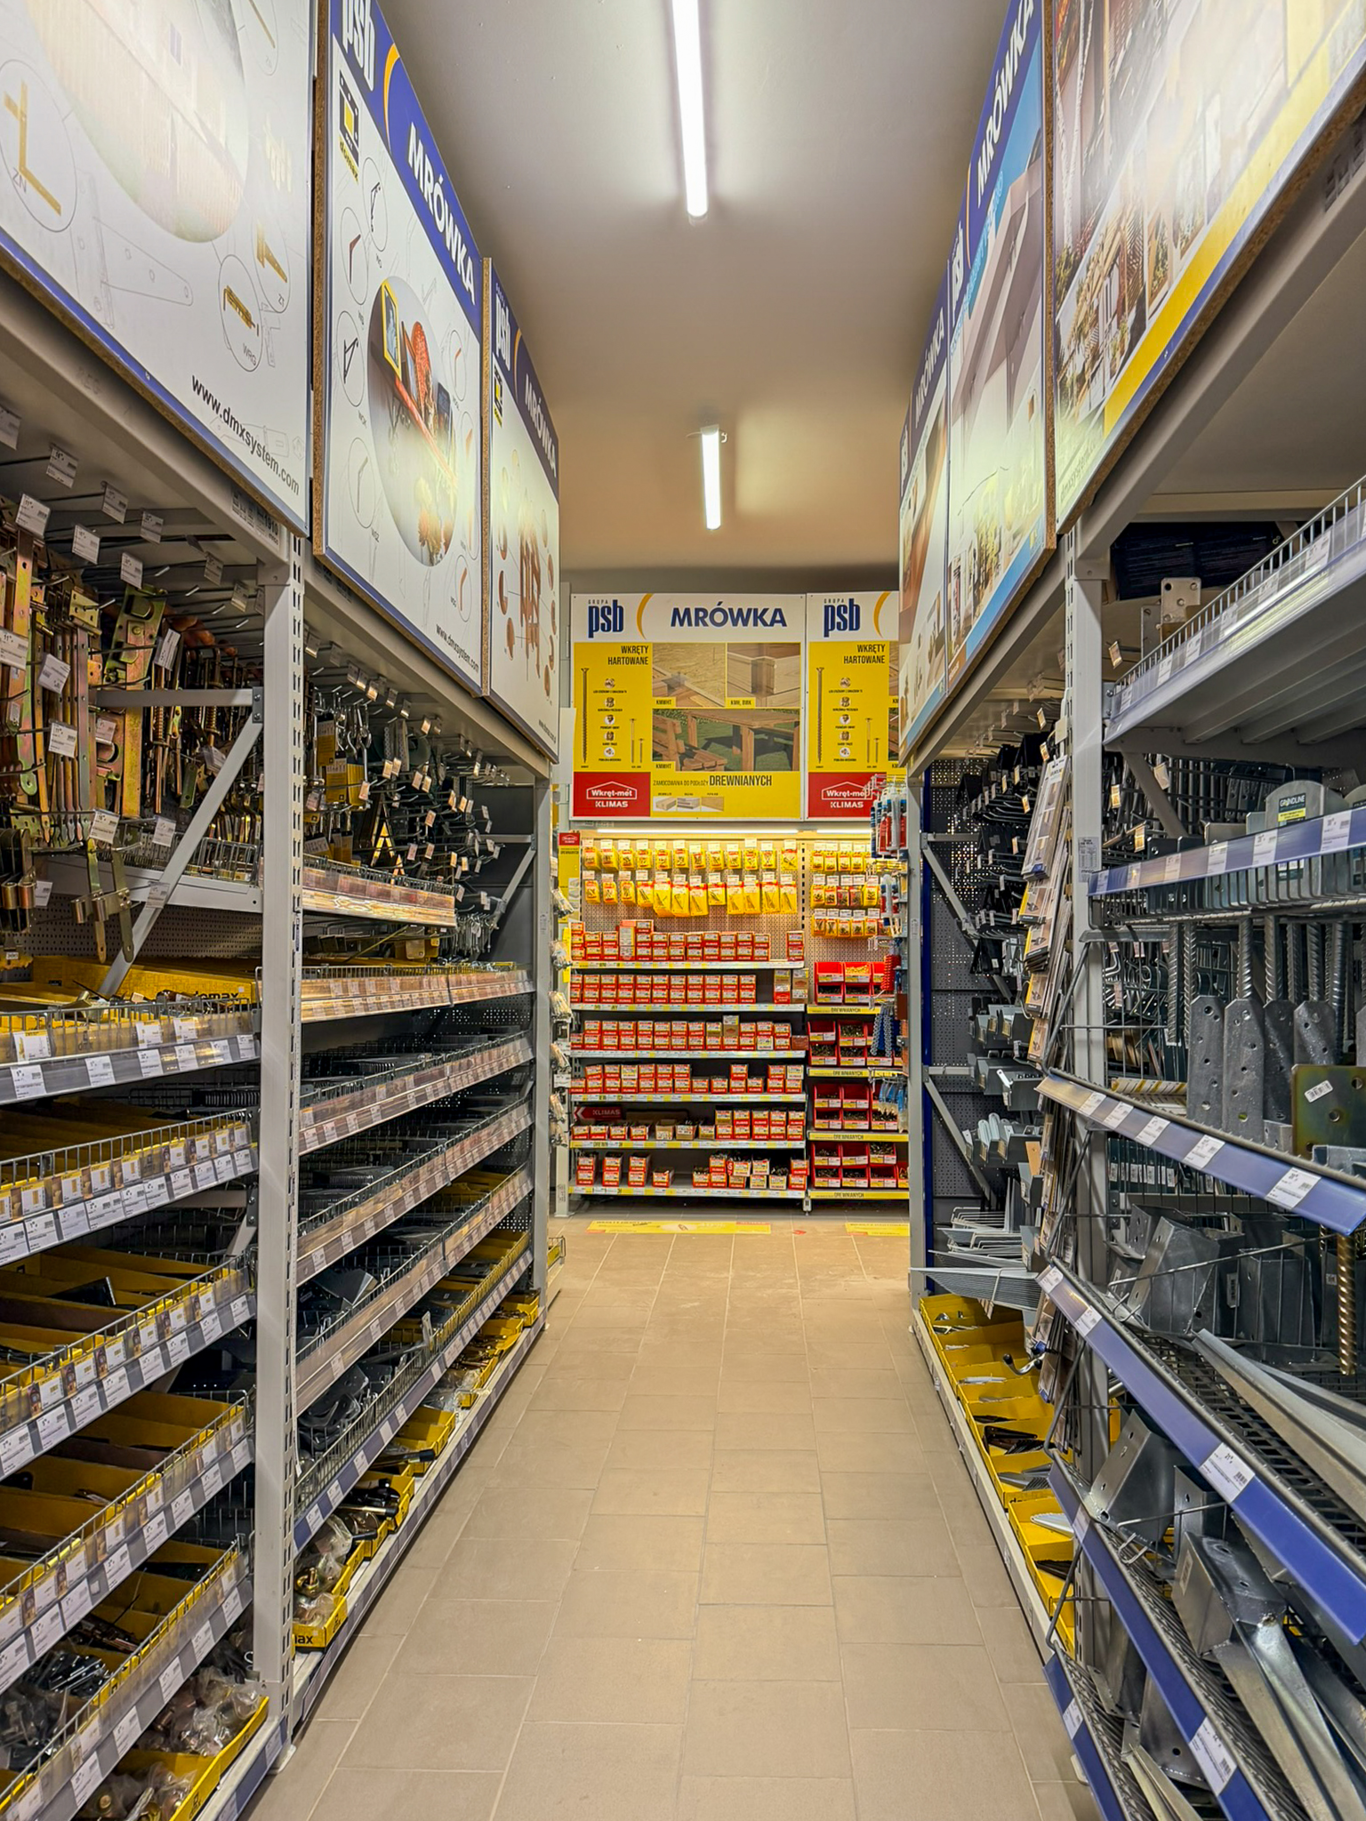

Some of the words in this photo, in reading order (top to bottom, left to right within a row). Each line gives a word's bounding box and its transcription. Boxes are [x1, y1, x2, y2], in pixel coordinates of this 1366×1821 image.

[407, 121, 476, 307] MRÓWKA
[523, 372, 558, 479] MRÓWKA
[192, 374, 301, 496] www.dmxsystem.com
[588, 599, 625, 638] psb
[670, 600, 788, 628] MRÓWKA
[823, 598, 861, 638] psb
[620, 645, 649, 656] WKRĘTY
[856, 644, 886, 655] WKRĘTY
[607, 656, 649, 666] HARTOWANE
[843, 655, 886, 665] HARTOWANE
[709, 775, 773, 787] DREWNIANYCH
[595, 799, 629, 808] KLIMAS
[830, 799, 865, 809] KLIMAS
